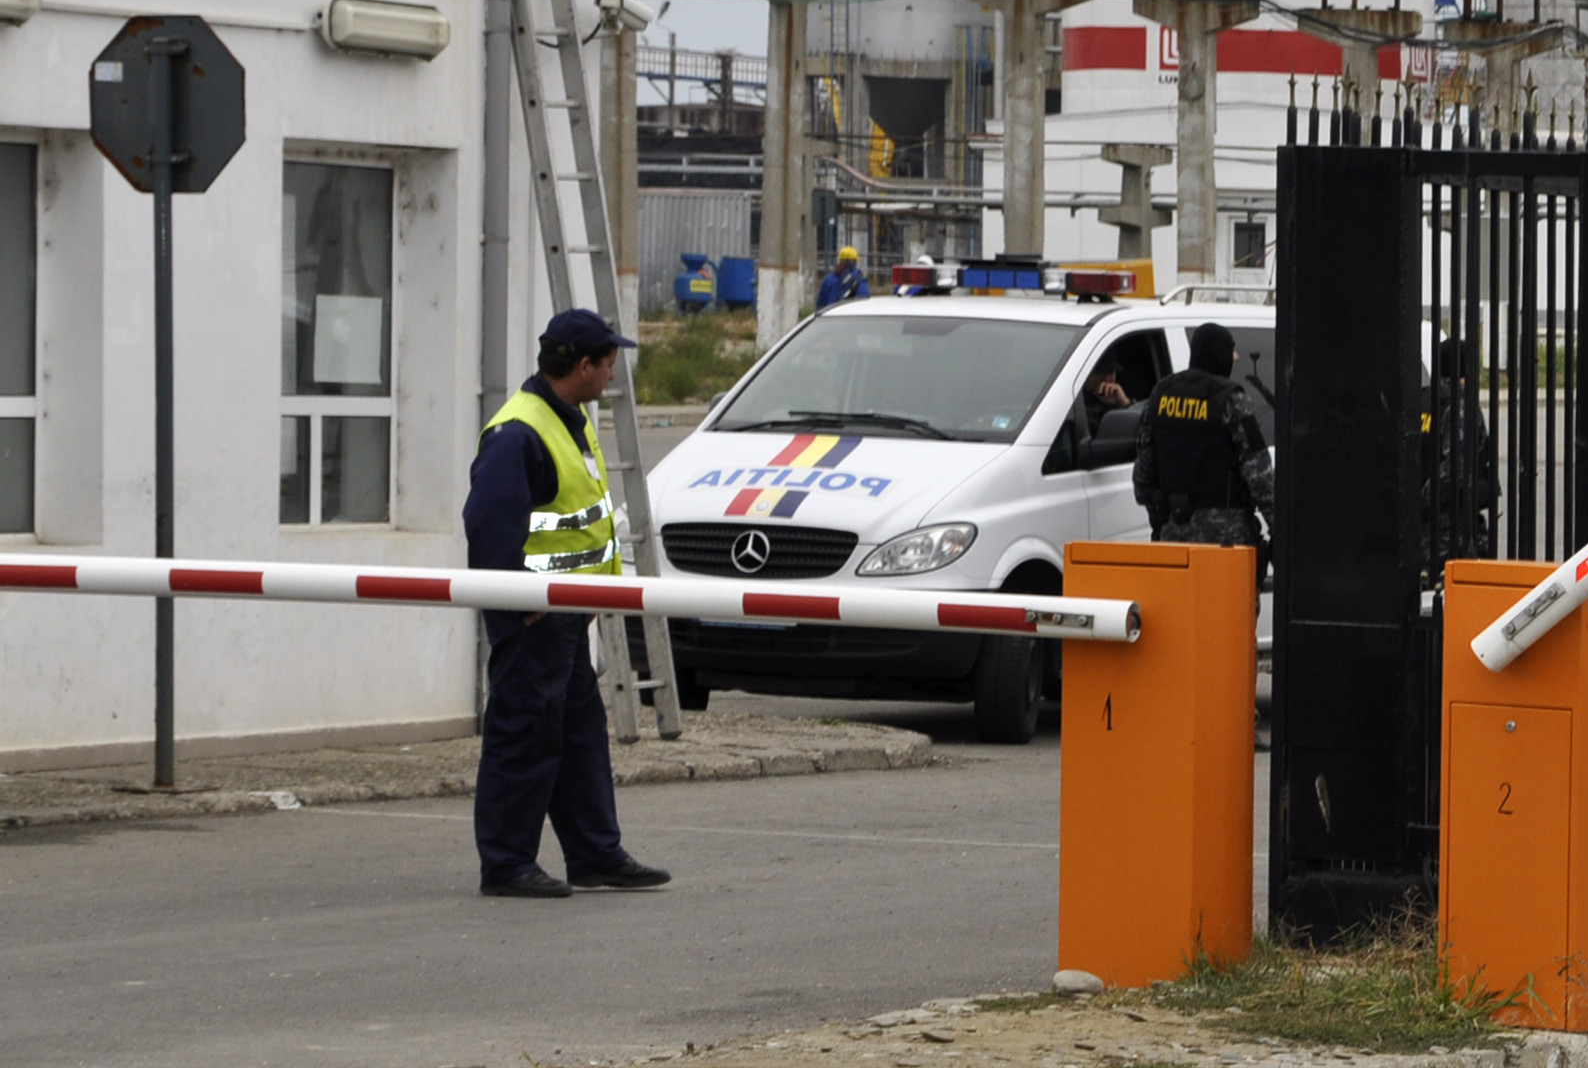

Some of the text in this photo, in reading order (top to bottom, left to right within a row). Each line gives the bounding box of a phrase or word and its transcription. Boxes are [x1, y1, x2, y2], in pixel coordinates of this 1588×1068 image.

[1158, 395, 1208, 420] POLITIA
[1101, 692, 1113, 731] 1
[1498, 782, 1513, 815] 2
